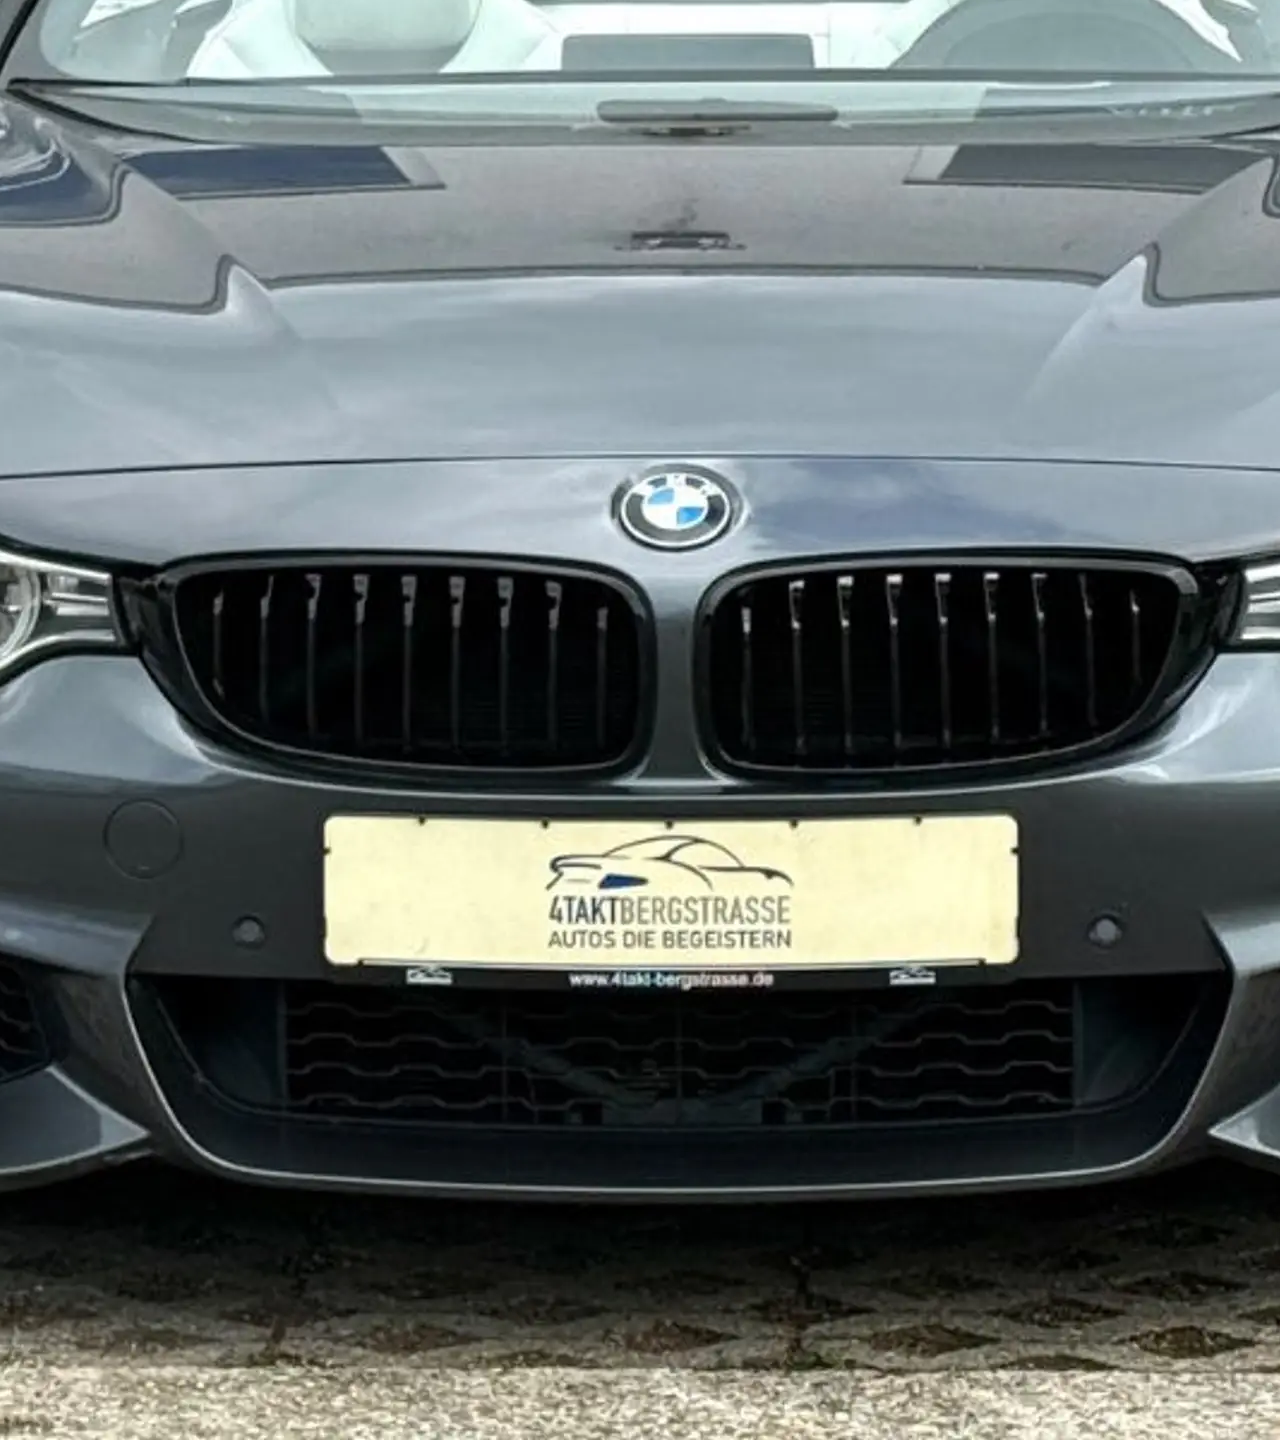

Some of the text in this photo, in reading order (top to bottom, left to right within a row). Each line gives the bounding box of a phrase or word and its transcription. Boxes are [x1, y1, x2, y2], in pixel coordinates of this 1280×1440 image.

[549, 895, 791, 925] 4TAKTBERGSTRASSE
[548, 929, 792, 948] AUTOS DIE BEGEISTERN
[569, 971, 774, 990] www.4takt-bergstrasse.de
